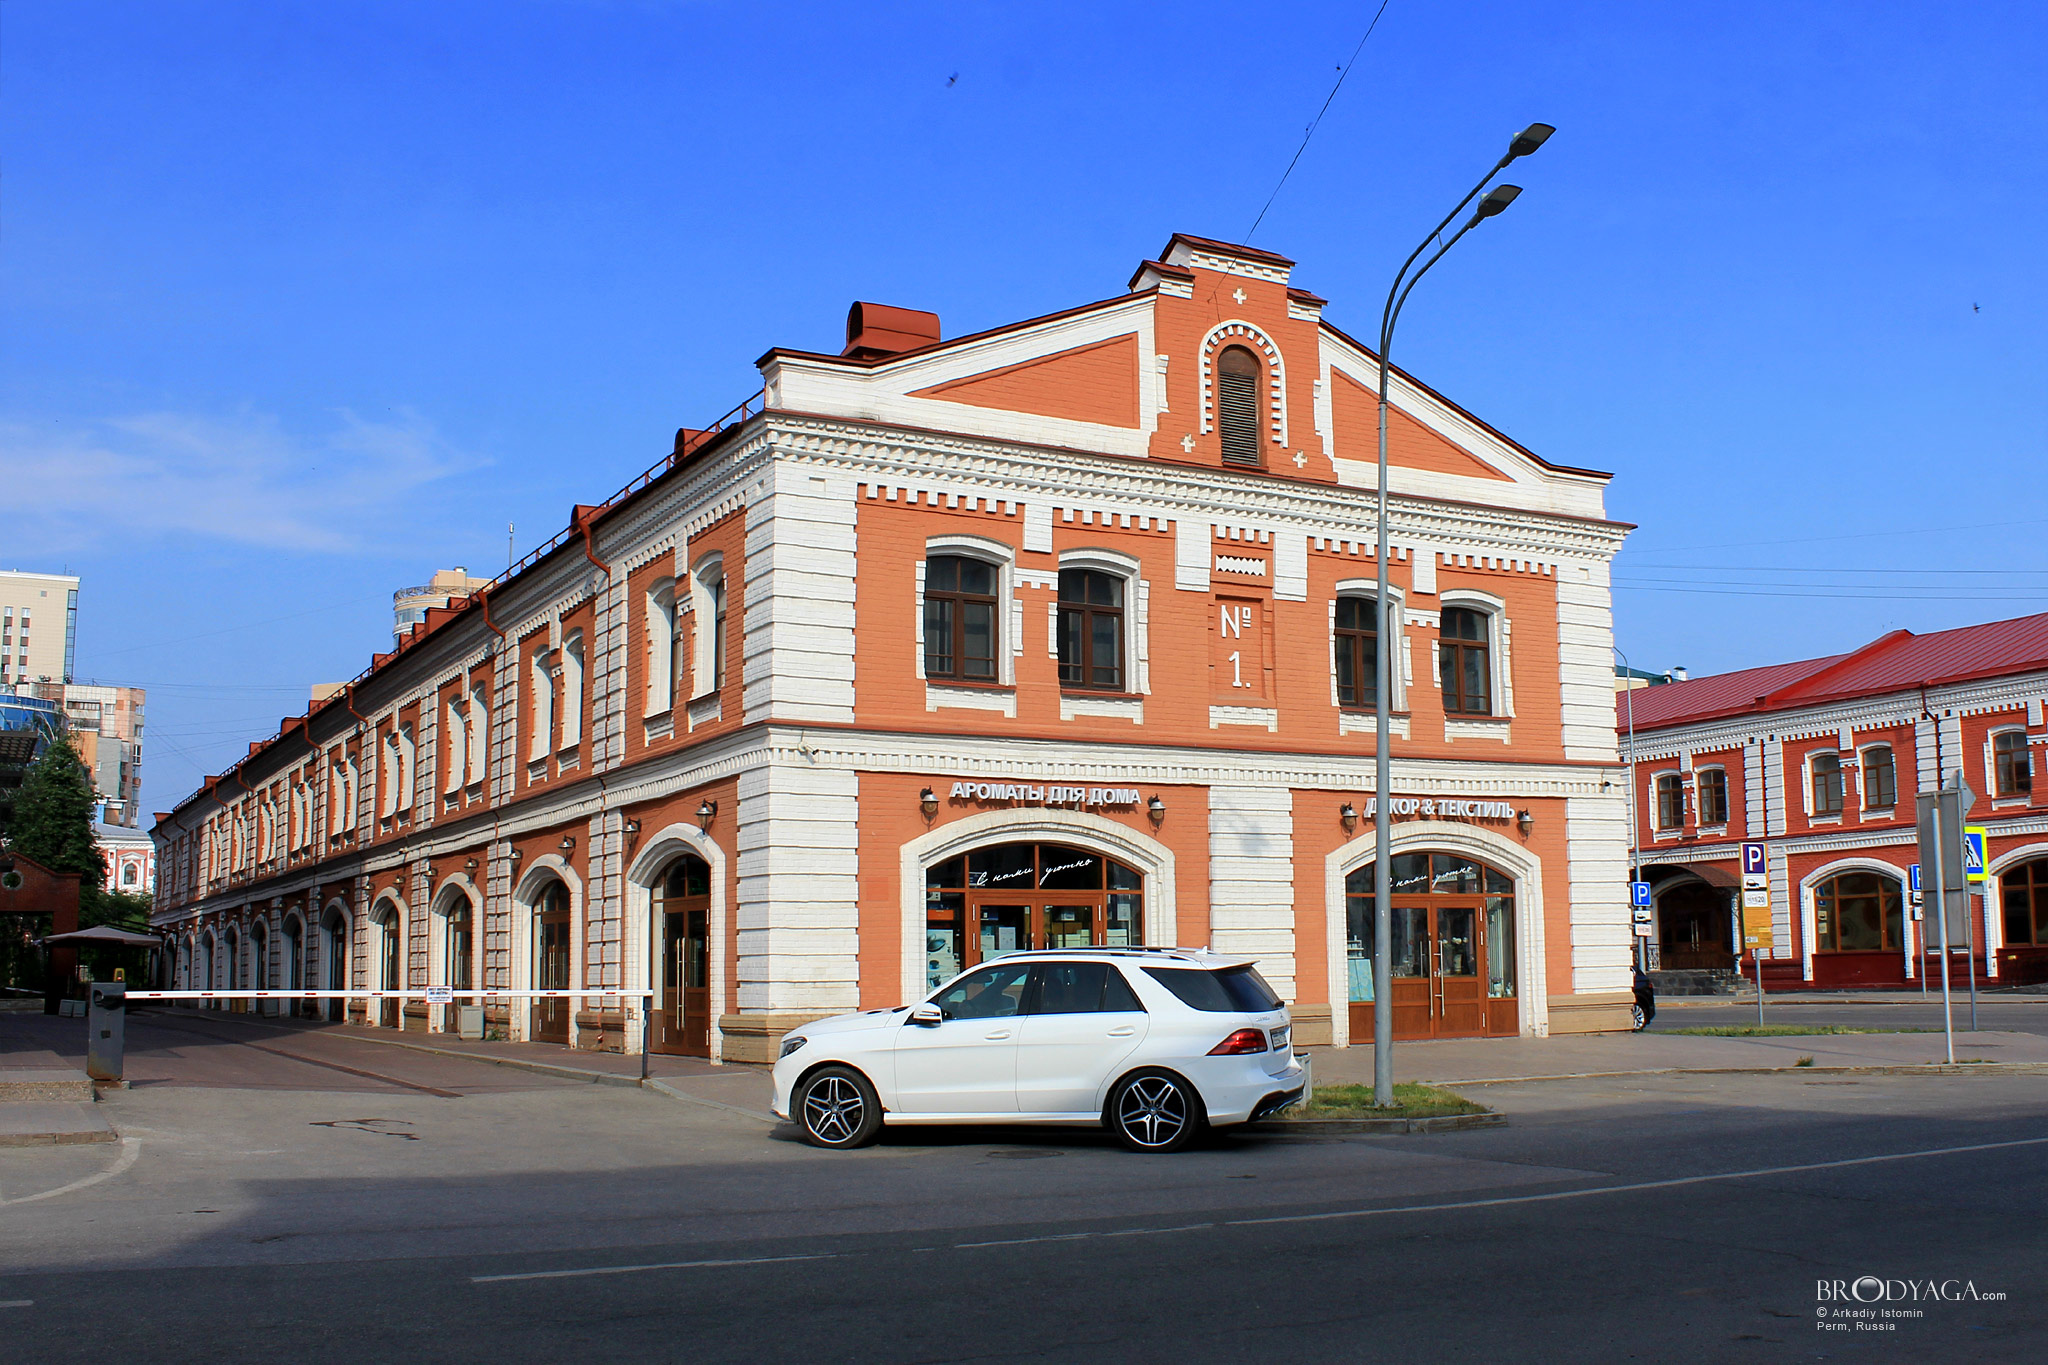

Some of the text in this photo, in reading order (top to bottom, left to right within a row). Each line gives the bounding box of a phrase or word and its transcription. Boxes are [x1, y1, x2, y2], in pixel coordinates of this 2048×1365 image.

[950, 782, 1142, 806] АРОМАТЫ ДЛЯ ДОМА
[1363, 797, 1516, 819] ДКОР & ТЕКСТИЛЬ
[1748, 846, 1762, 872] P
[1637, 885, 1648, 903] P
